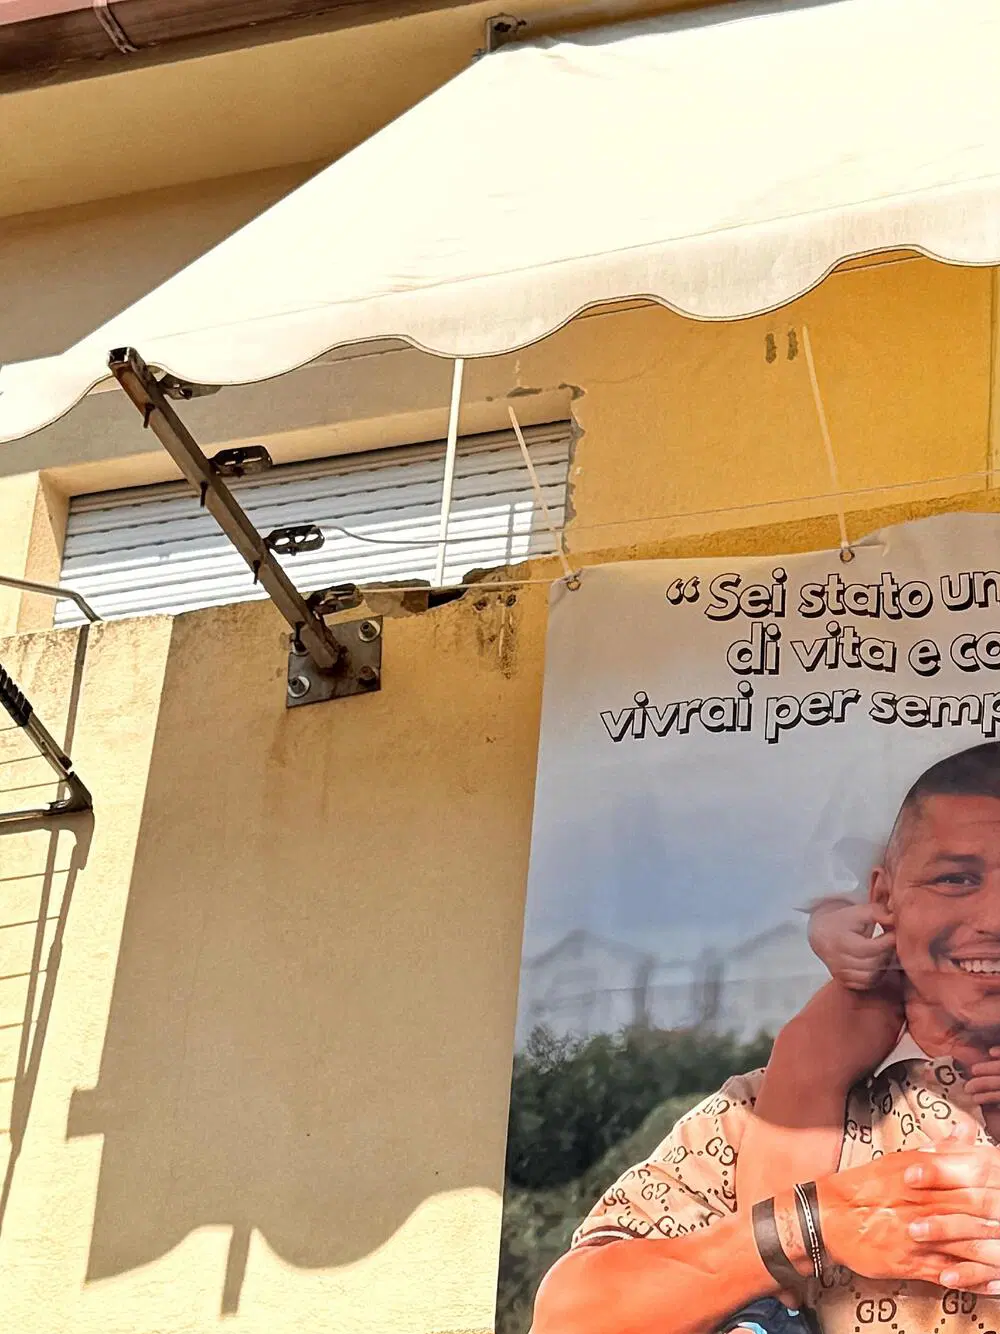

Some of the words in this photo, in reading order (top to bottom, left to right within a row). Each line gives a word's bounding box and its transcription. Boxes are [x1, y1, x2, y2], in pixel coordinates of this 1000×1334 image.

[798, 571, 933, 620] stato
[727, 621, 781, 675] di
[790, 620, 896, 672] vita
[908, 639, 942, 676] e
[600, 680, 753, 742] vivrai
[765, 689, 861, 743] per
